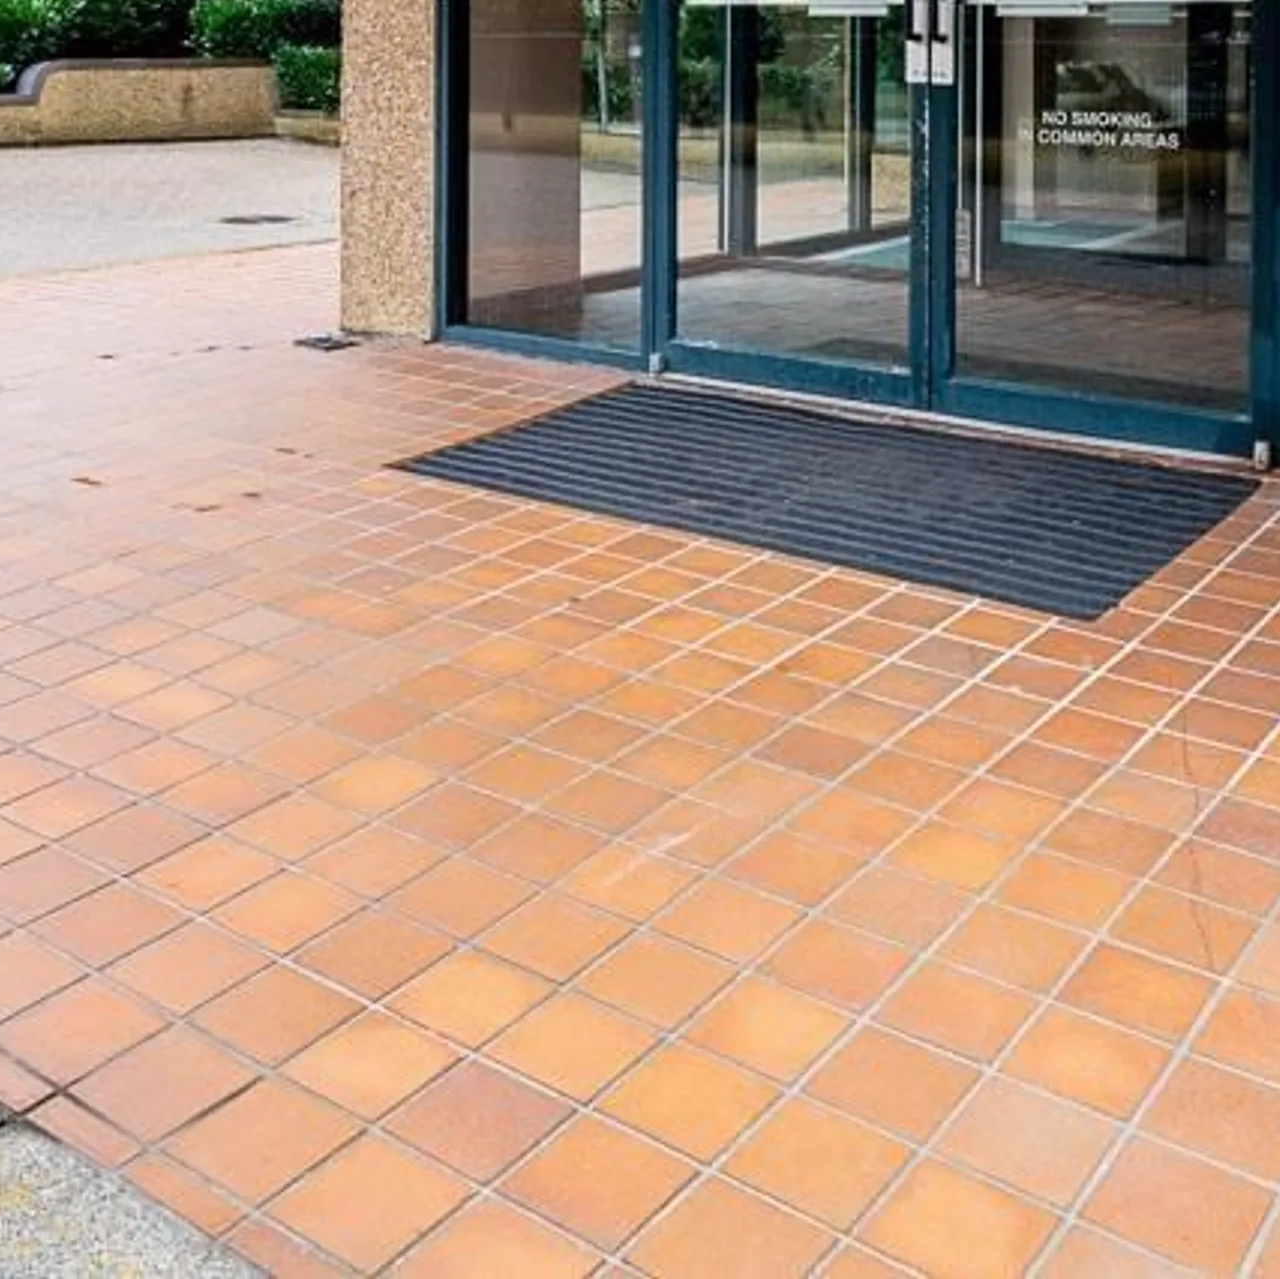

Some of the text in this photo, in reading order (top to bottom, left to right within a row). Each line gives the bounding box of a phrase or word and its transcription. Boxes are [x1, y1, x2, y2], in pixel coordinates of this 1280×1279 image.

[1041, 111, 1152, 129] NO SMOKING
[1037, 129, 1116, 146] COMMON
[1120, 131, 1180, 149] AREAS
